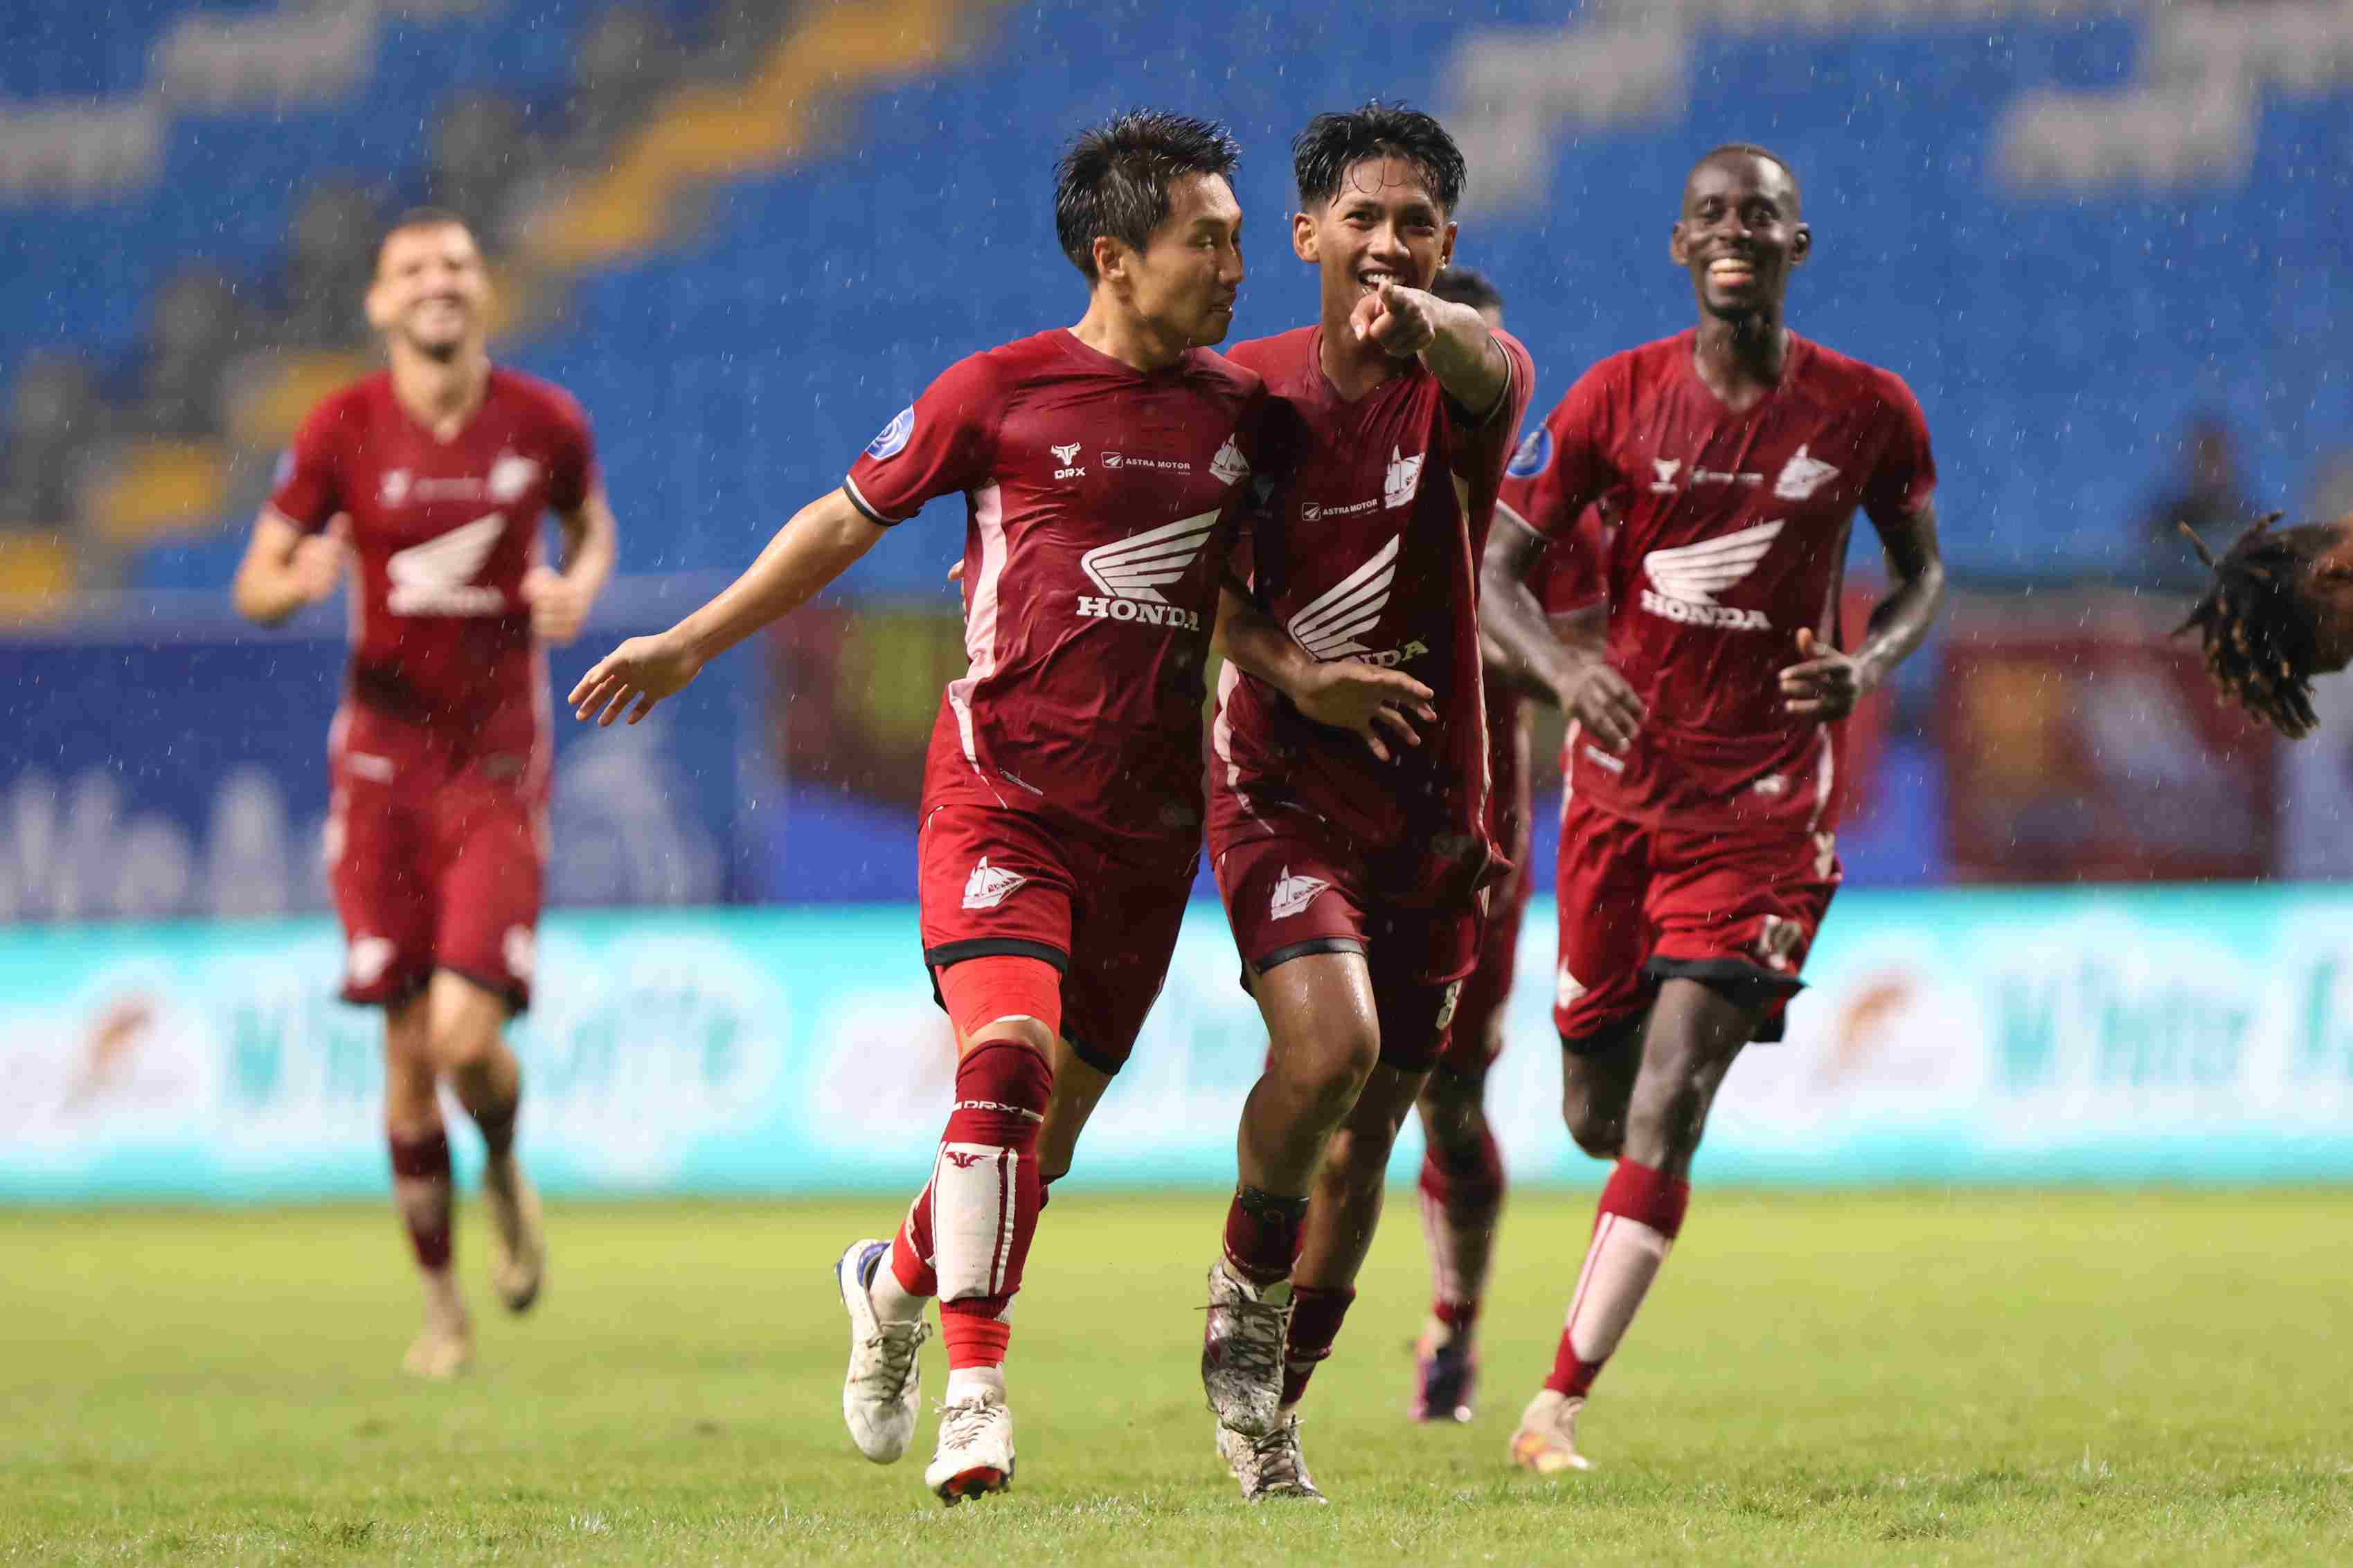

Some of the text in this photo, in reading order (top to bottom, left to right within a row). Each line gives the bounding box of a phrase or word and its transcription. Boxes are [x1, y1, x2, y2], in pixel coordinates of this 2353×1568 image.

[1125, 458, 1191, 470] ASTRA MOTOR
[1054, 467, 1086, 479] DRX
[1322, 506, 1350, 516] ASTRA
[1350, 498, 1378, 513] MOTOR
[1639, 588, 1773, 630] HONDA
[963, 1100, 1019, 1113] DRX
